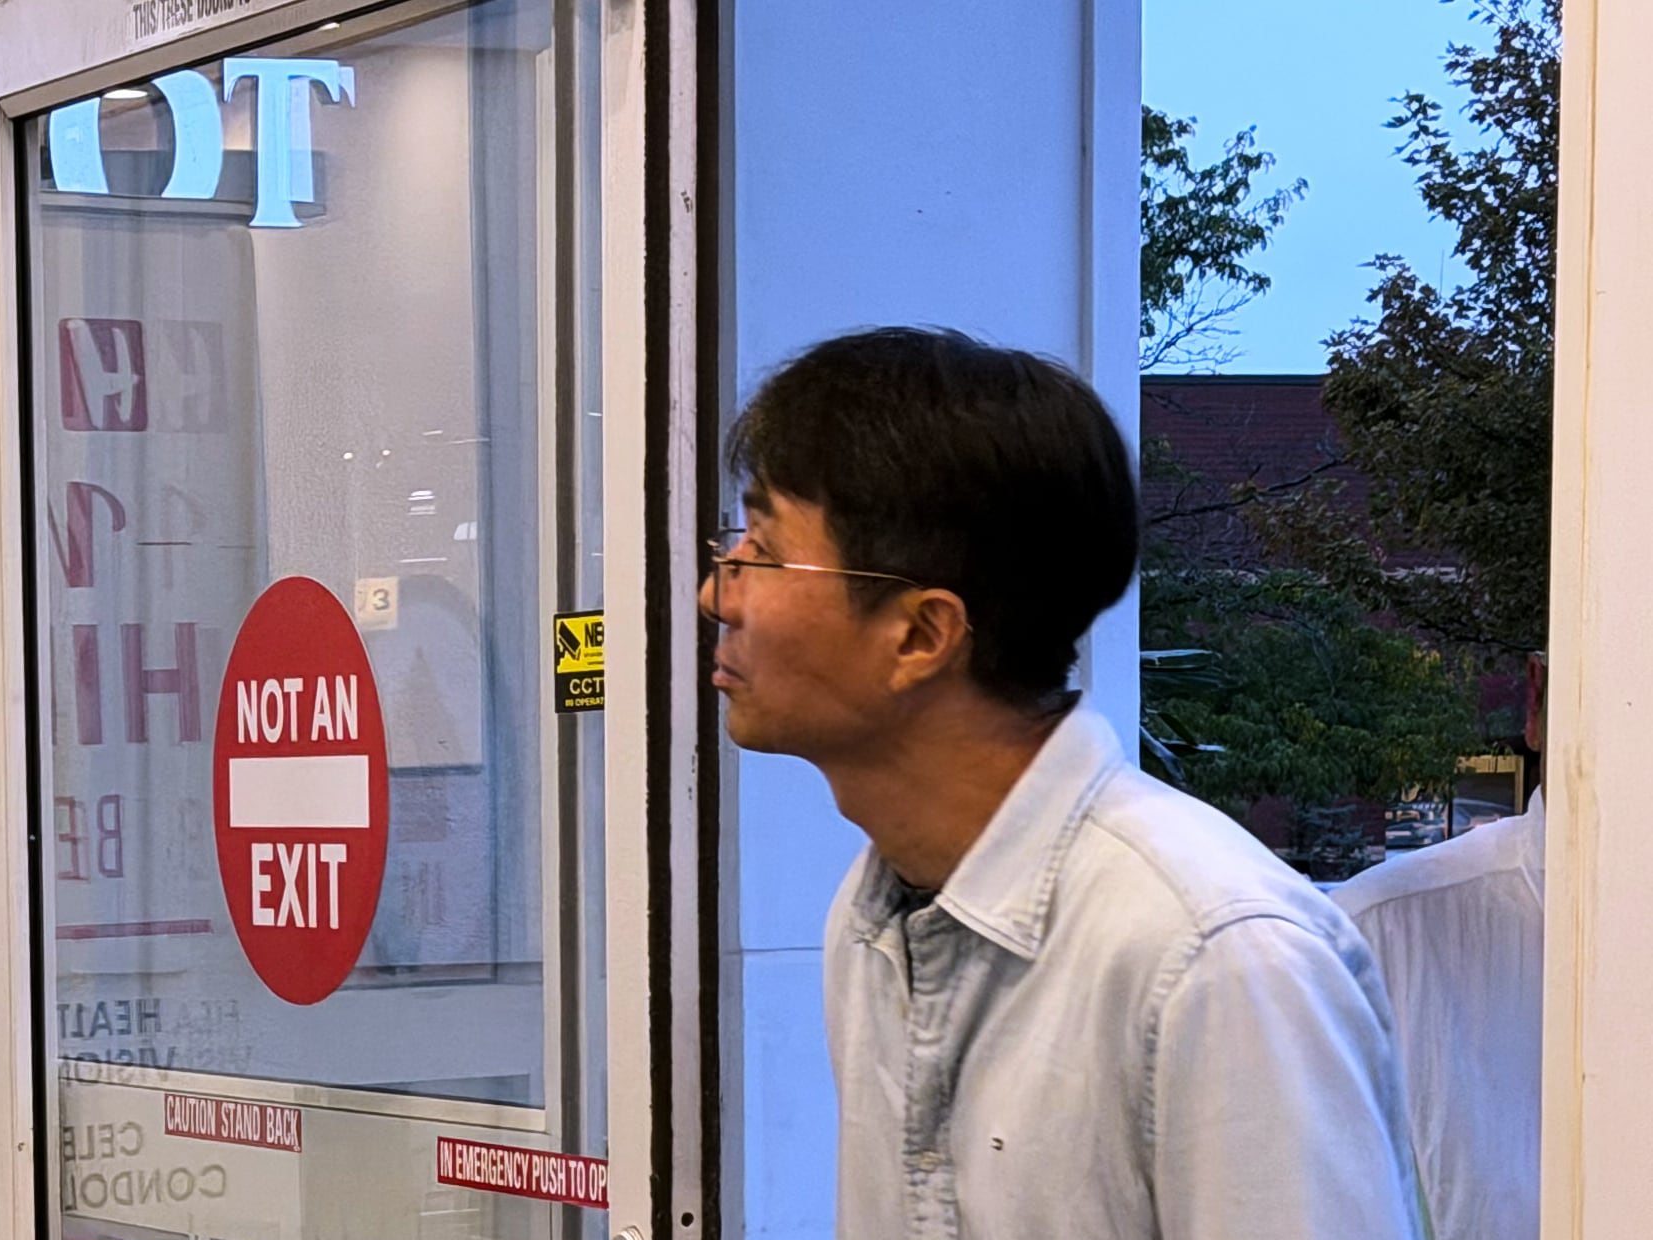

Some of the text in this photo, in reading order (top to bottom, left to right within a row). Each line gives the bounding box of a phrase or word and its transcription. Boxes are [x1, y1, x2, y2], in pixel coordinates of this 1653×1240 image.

[237, 678, 303, 743] NOT
[311, 674, 358, 741] AN
[569, 677, 604, 694] CCT
[575, 696, 604, 707] OPERAT
[251, 843, 347, 929] EXIT
[167, 1096, 298, 1146] CAUTION STAND BACK
[440, 1141, 609, 1202] IN EMERGENCY PUSH TO OP
